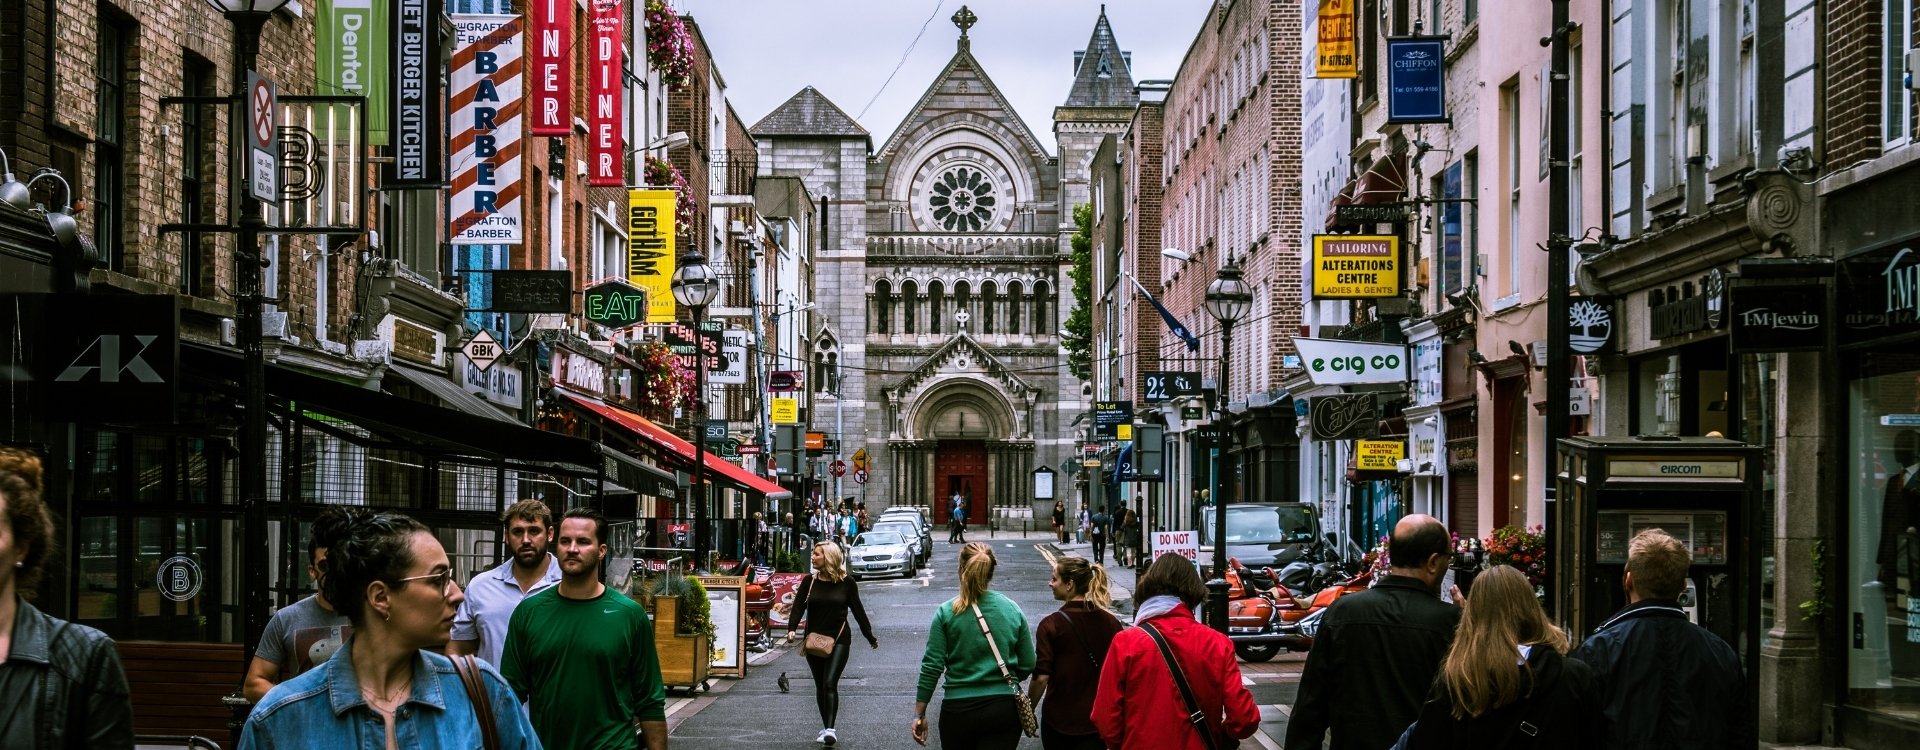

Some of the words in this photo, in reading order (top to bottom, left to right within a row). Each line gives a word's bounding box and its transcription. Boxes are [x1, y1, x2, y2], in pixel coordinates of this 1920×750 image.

[466, 22, 518, 32] GRAFTON
[1320, 17, 1352, 39] CENTRE
[468, 35, 513, 45] BARBER
[342, 14, 363, 91] Dental
[403, 33, 422, 99] BURGER
[1394, 59, 1438, 68] CHIFFON
[598, 37, 613, 177] DINER
[473, 51, 500, 214] BARBER
[403, 105, 422, 179] KITCHEN
[465, 217, 517, 226] GRAFTON
[467, 229, 513, 238] BARBER
[630, 206, 669, 276] GOTHAM
[1328, 243, 1387, 253] TAILORING
[1322, 260, 1394, 271] ALTERATIONS
[1337, 273, 1378, 284] CENTRE
[1321, 286, 1351, 294] LADIES
[1355, 286, 1361, 294] &
[1364, 286, 1393, 294] GENTS
[588, 292, 642, 321] EAT
[471, 344, 494, 357] GBK
[1311, 358, 1325, 372] e
[1330, 356, 1366, 375] cig
[1370, 354, 1400, 370] co
[507, 373, 516, 398] SIX
[1146, 376, 1170, 399] 22
[1122, 462, 1131, 474] 2
[1159, 534, 1171, 545] DO
[1173, 533, 1190, 545] NOT
[1177, 548, 1197, 560] THIS
